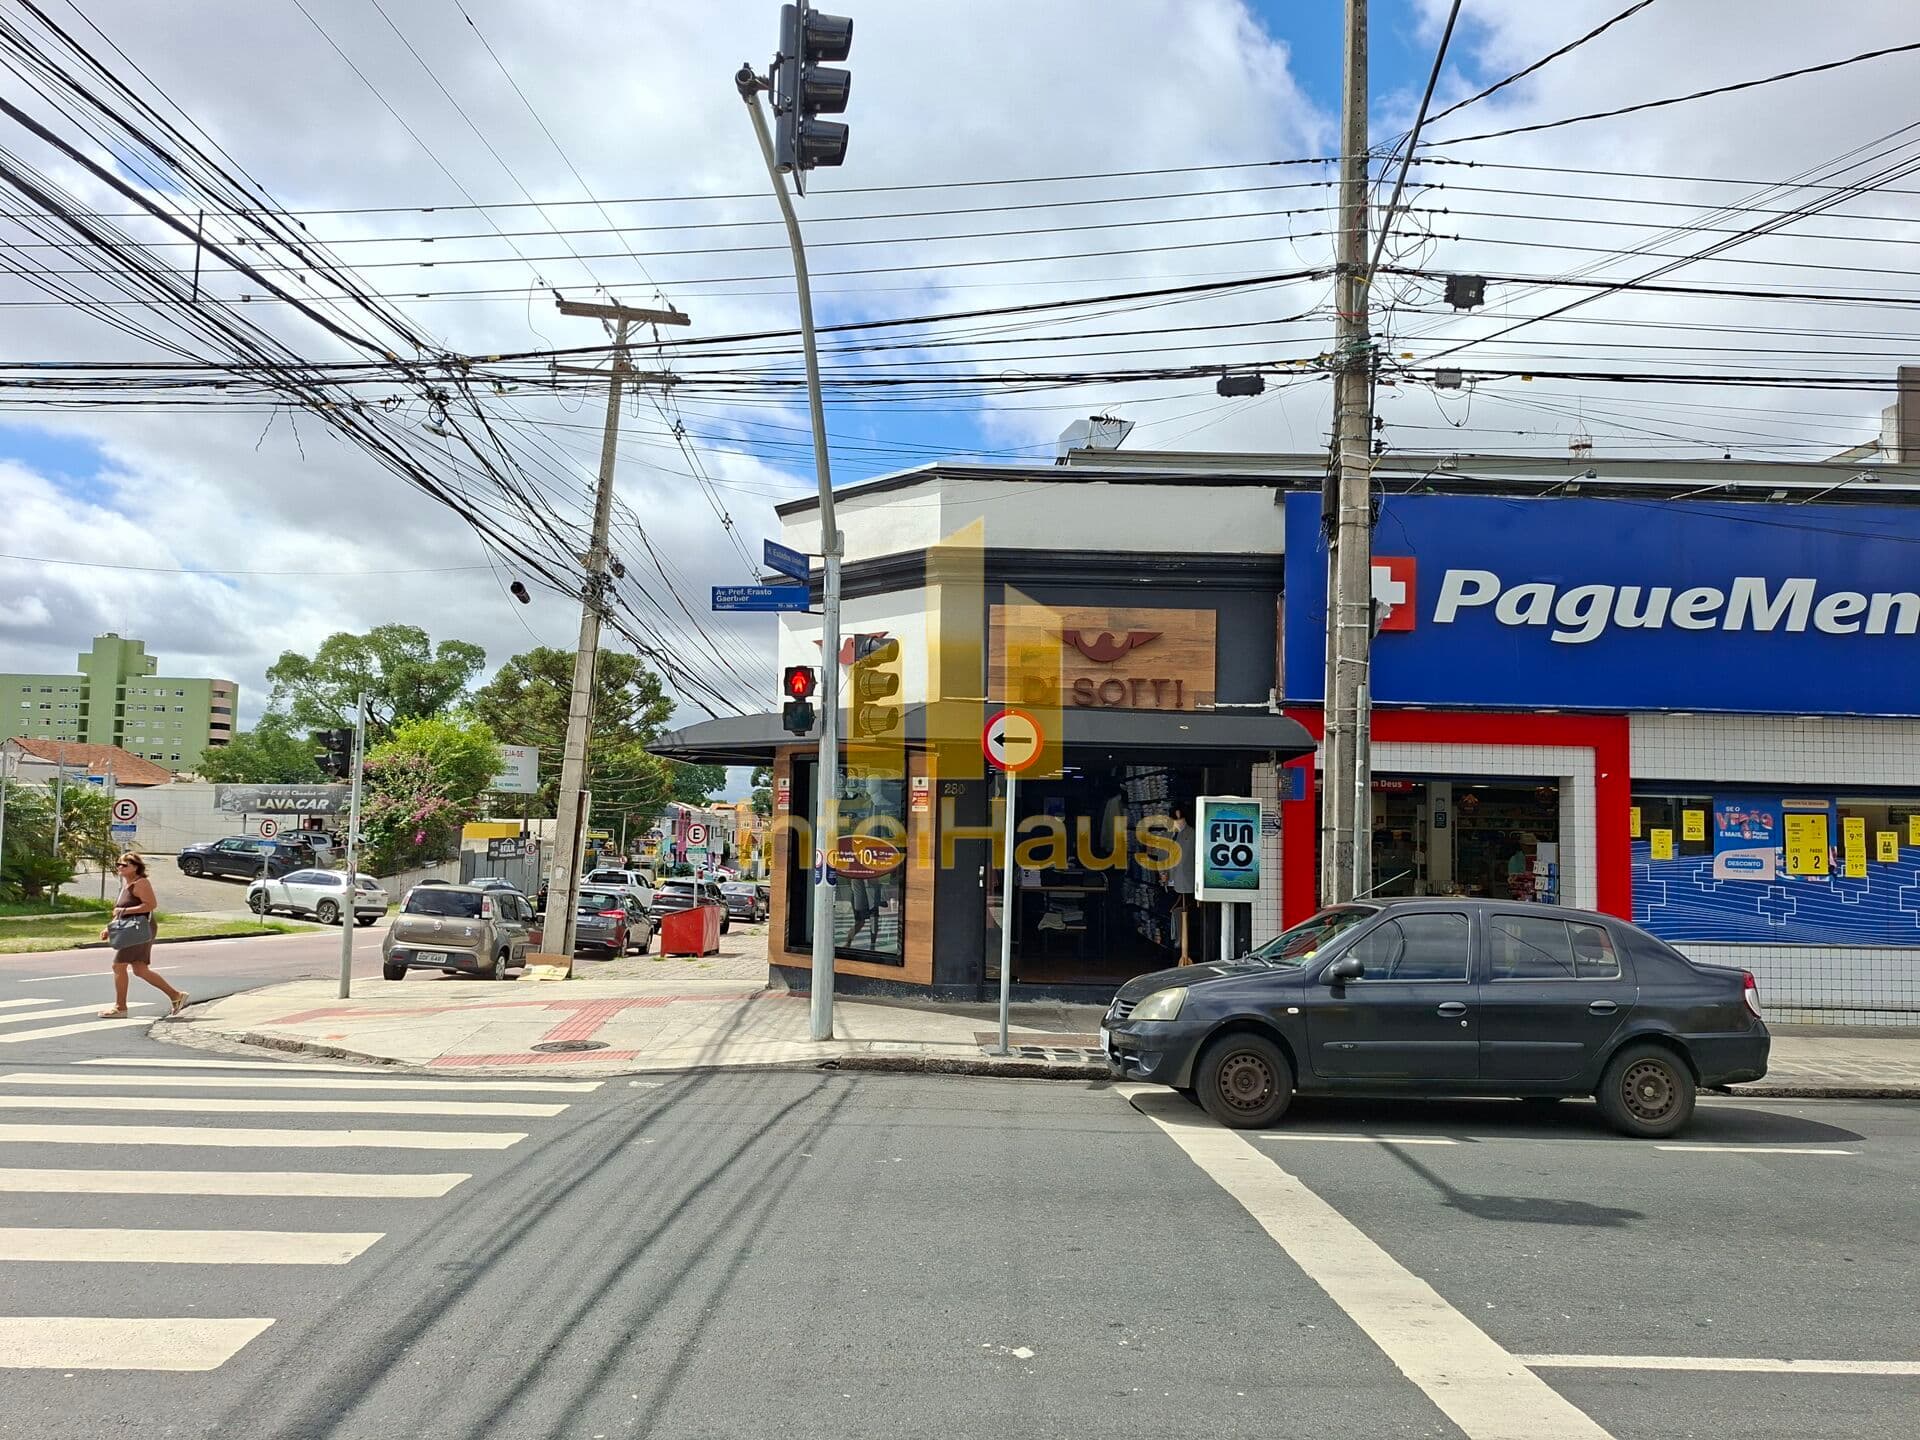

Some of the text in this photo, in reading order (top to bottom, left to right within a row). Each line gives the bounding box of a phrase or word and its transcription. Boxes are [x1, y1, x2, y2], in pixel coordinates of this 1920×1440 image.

[747, 588, 772, 596] Erasto
[1432, 568, 1920, 644] PagueMen
[1073, 677, 1184, 708] SOTTI
[1381, 780, 1402, 788] Deus
[121, 803, 131, 817] E
[256, 798, 330, 811] LAVACAR
[265, 823, 272, 834] E
[692, 828, 701, 840] E
[1210, 824, 1254, 843] FUN
[1210, 844, 1254, 867] GO
[1792, 855, 1799, 869] 3
[1813, 855, 1821, 869] 2
